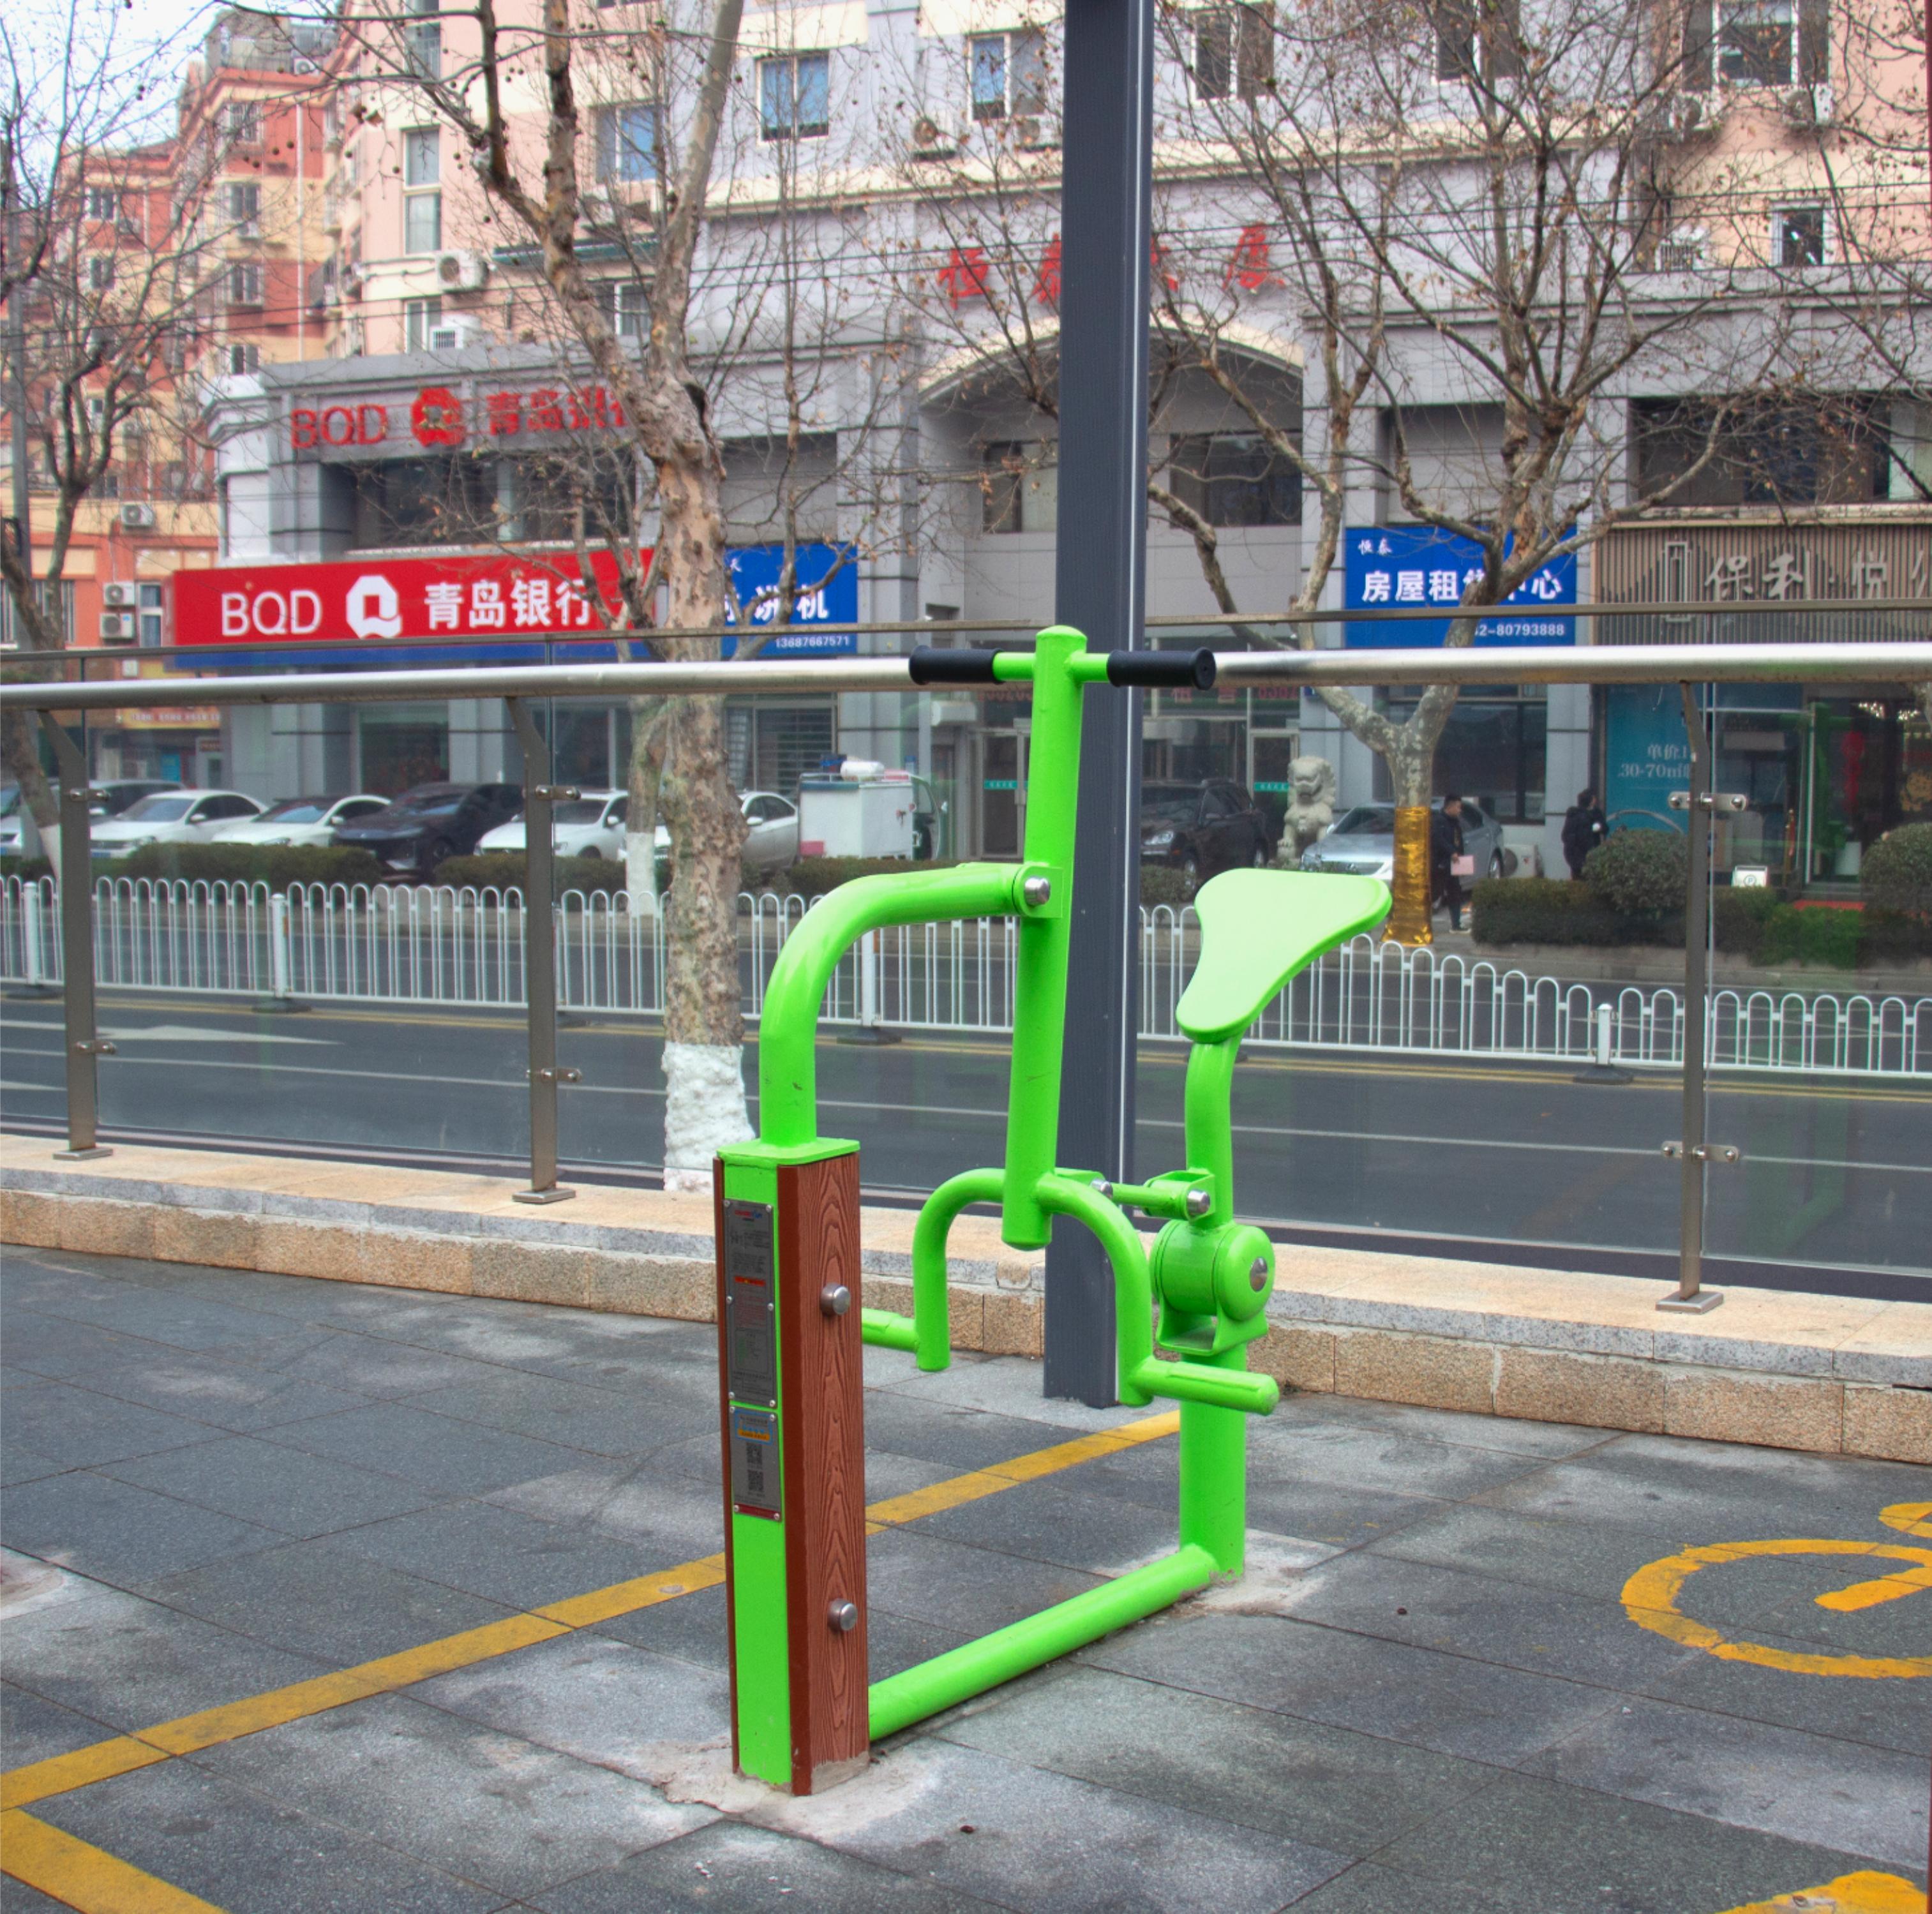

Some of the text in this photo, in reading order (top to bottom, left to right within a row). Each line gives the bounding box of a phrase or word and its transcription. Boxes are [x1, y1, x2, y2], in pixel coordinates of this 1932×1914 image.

[290, 404, 389, 449] BQD
[221, 590, 322, 636] BQD
[424, 579, 590, 631] 青岛银行
[1362, 569, 1562, 602] 房屋租心
